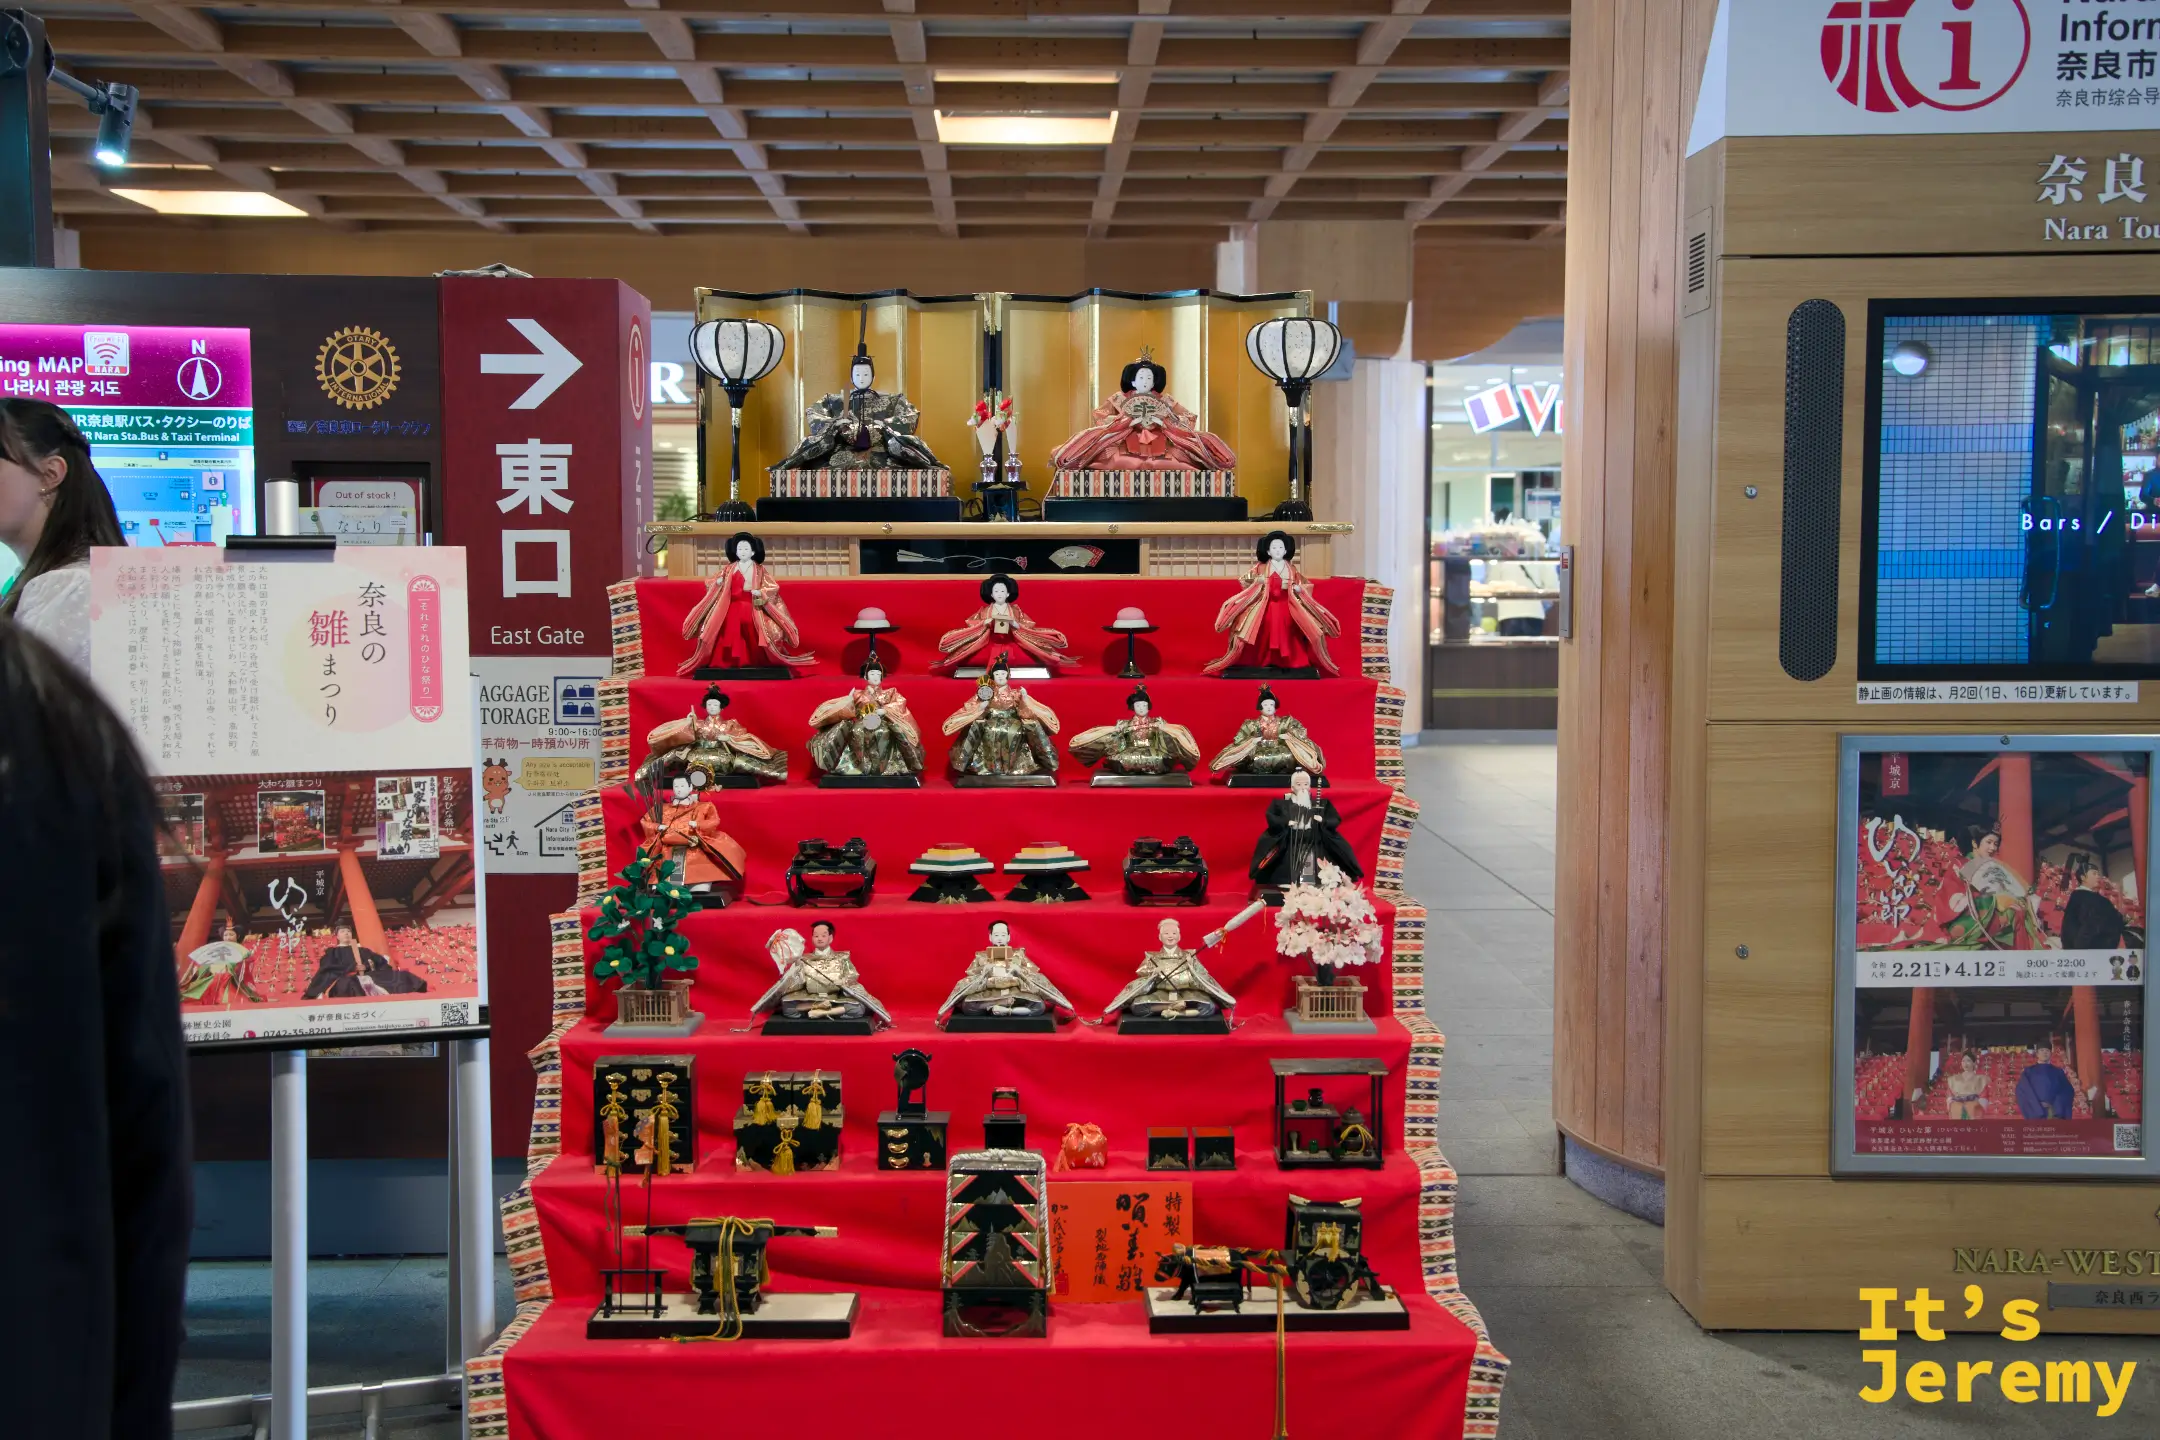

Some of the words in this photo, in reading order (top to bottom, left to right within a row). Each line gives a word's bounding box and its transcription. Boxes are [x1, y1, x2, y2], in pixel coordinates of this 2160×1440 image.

[2057, 49, 2158, 80] 奈良市
[2056, 87, 2160, 107] 奈良市综合导
[2036, 153, 2148, 206] 奈良
[2043, 216, 2108, 240] Nara
[192, 340, 206, 354] N
[38, 357, 84, 373] MAP
[94, 366, 121, 374] NARA
[4, 379, 50, 396] 나라시
[54, 379, 86, 396] 관광
[90, 380, 121, 396] 지도
[329, 381, 390, 402] INTERNATIONAL
[82, 431, 92, 441] R
[95, 432, 119, 441] Nara
[161, 432, 170, 441] &
[171, 432, 193, 441] Taxi
[195, 432, 240, 442] Terminal
[335, 491, 352, 500] Out
[354, 491, 365, 500] of
[366, 491, 391, 500] stock
[496, 438, 574, 597] 東口
[2022, 513, 2081, 530] Bars
[358, 582, 388, 664] 奈良の
[491, 626, 531, 645] East
[537, 626, 585, 645] Gate
[420, 602, 432, 695] それぞれのひな祭り
[308, 610, 351, 726] 雛まつり
[480, 685, 550, 702] AGGAGE
[481, 707, 550, 725] TORAGE
[482, 738, 590, 750] 手荷物一時預かり所
[258, 779, 322, 790] 大和な雛まつり
[443, 777, 454, 836] 町家のひな祭り
[316, 870, 325, 896] 平城京
[1892, 962, 1932, 978] 2.21
[1955, 961, 1996, 977] 4.12
[308, 1010, 377, 1023] 春が奈良に近づく
[1163, 1192, 1182, 1236] 特製
